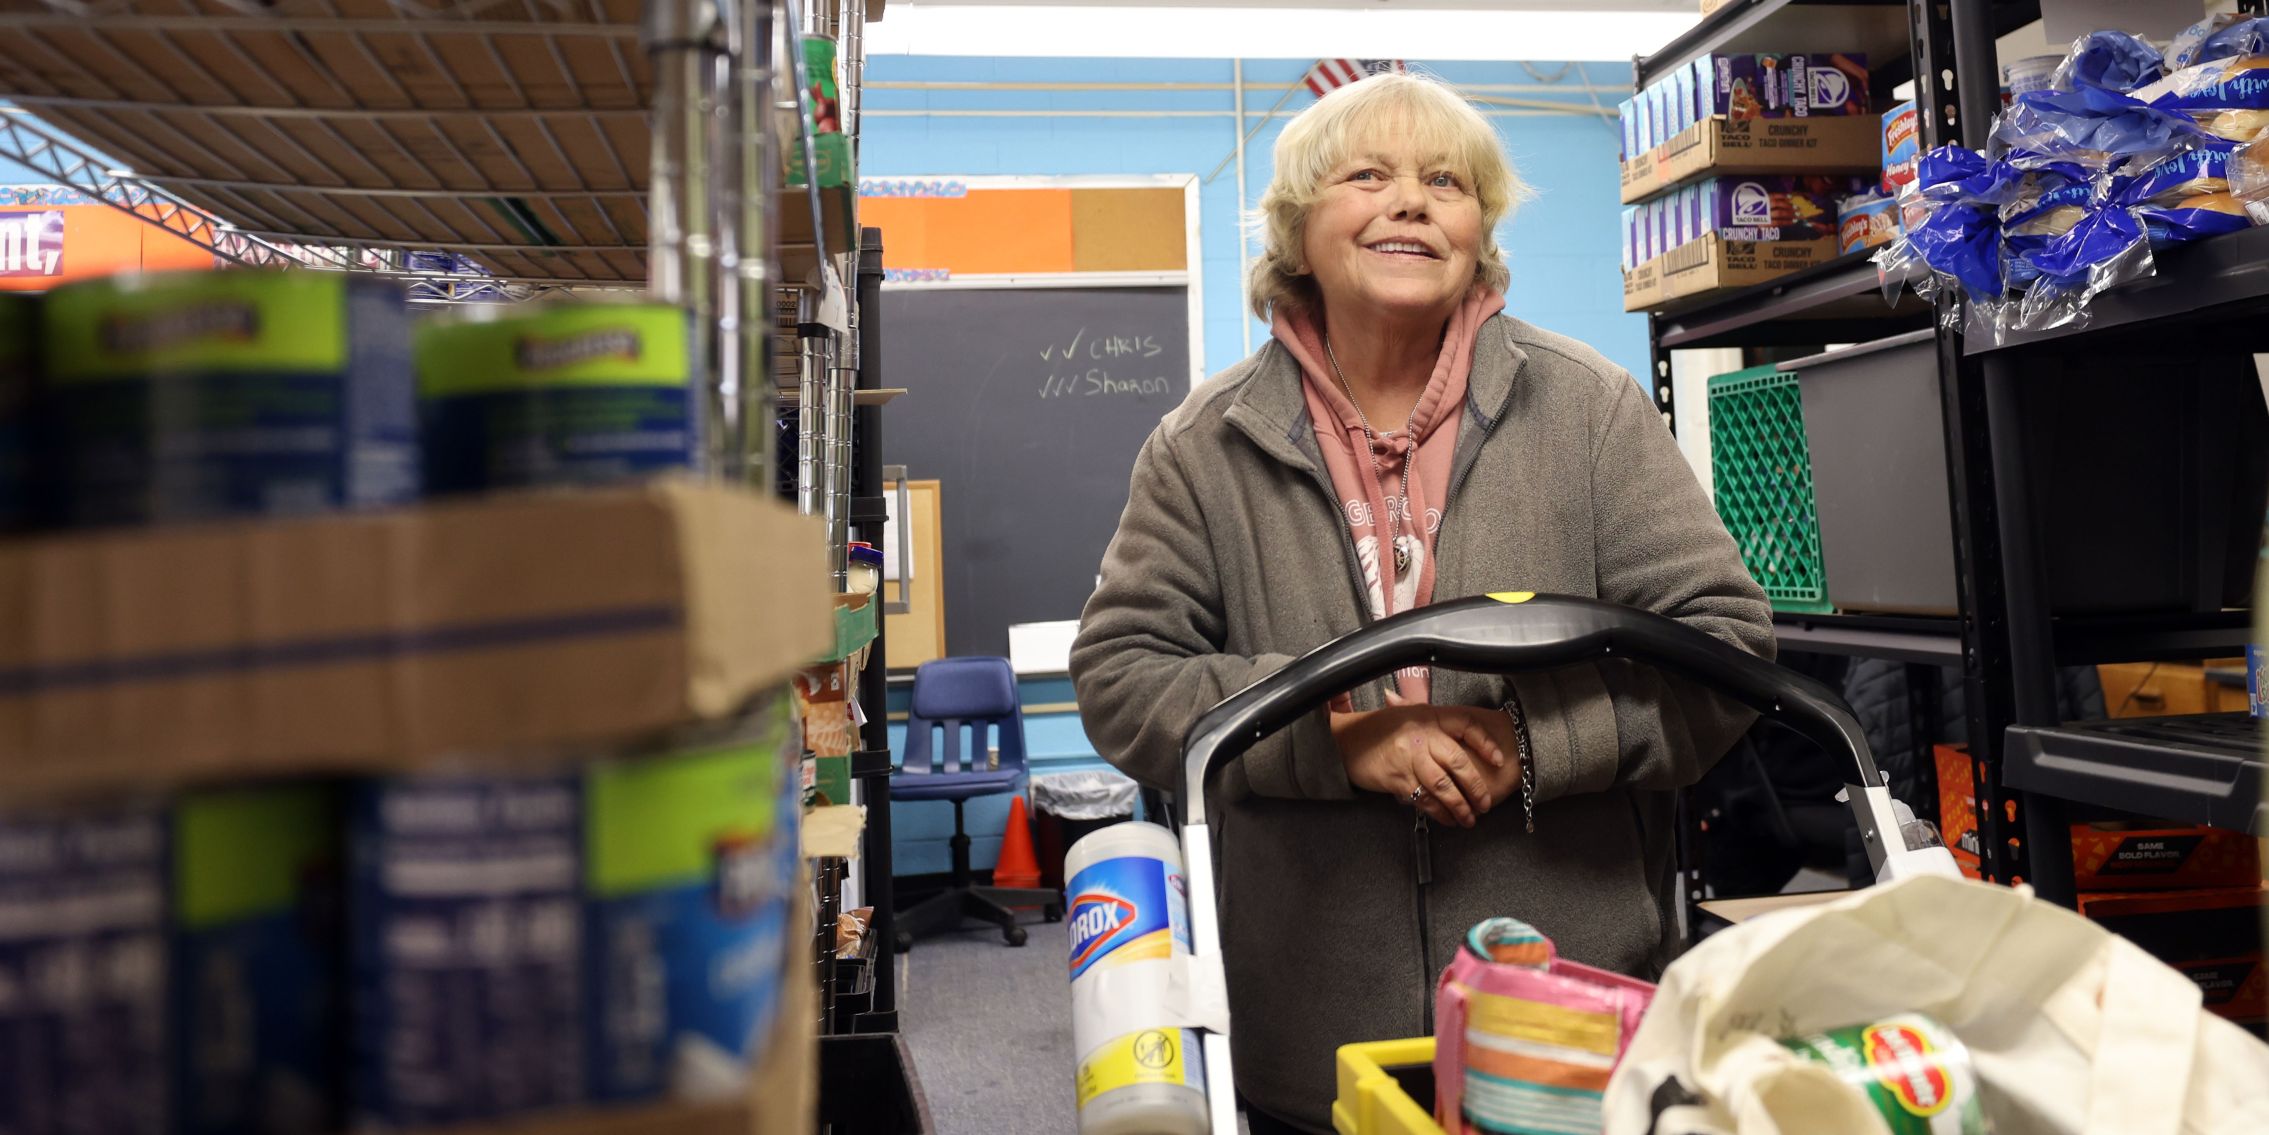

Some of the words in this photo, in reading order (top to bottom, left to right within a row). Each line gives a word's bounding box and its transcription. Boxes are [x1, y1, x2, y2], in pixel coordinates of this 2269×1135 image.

[1791, 56, 1806, 95] CRUNCHY
[1794, 96, 1808, 118] TACO
[1768, 125, 1808, 136] CRUNCHY
[1723, 227, 1759, 241] CRUNCHY
[1762, 227, 1780, 240] TACO
[1773, 247, 1813, 258] CRUNCHY
[1085, 369, 1169, 396] Sharon
